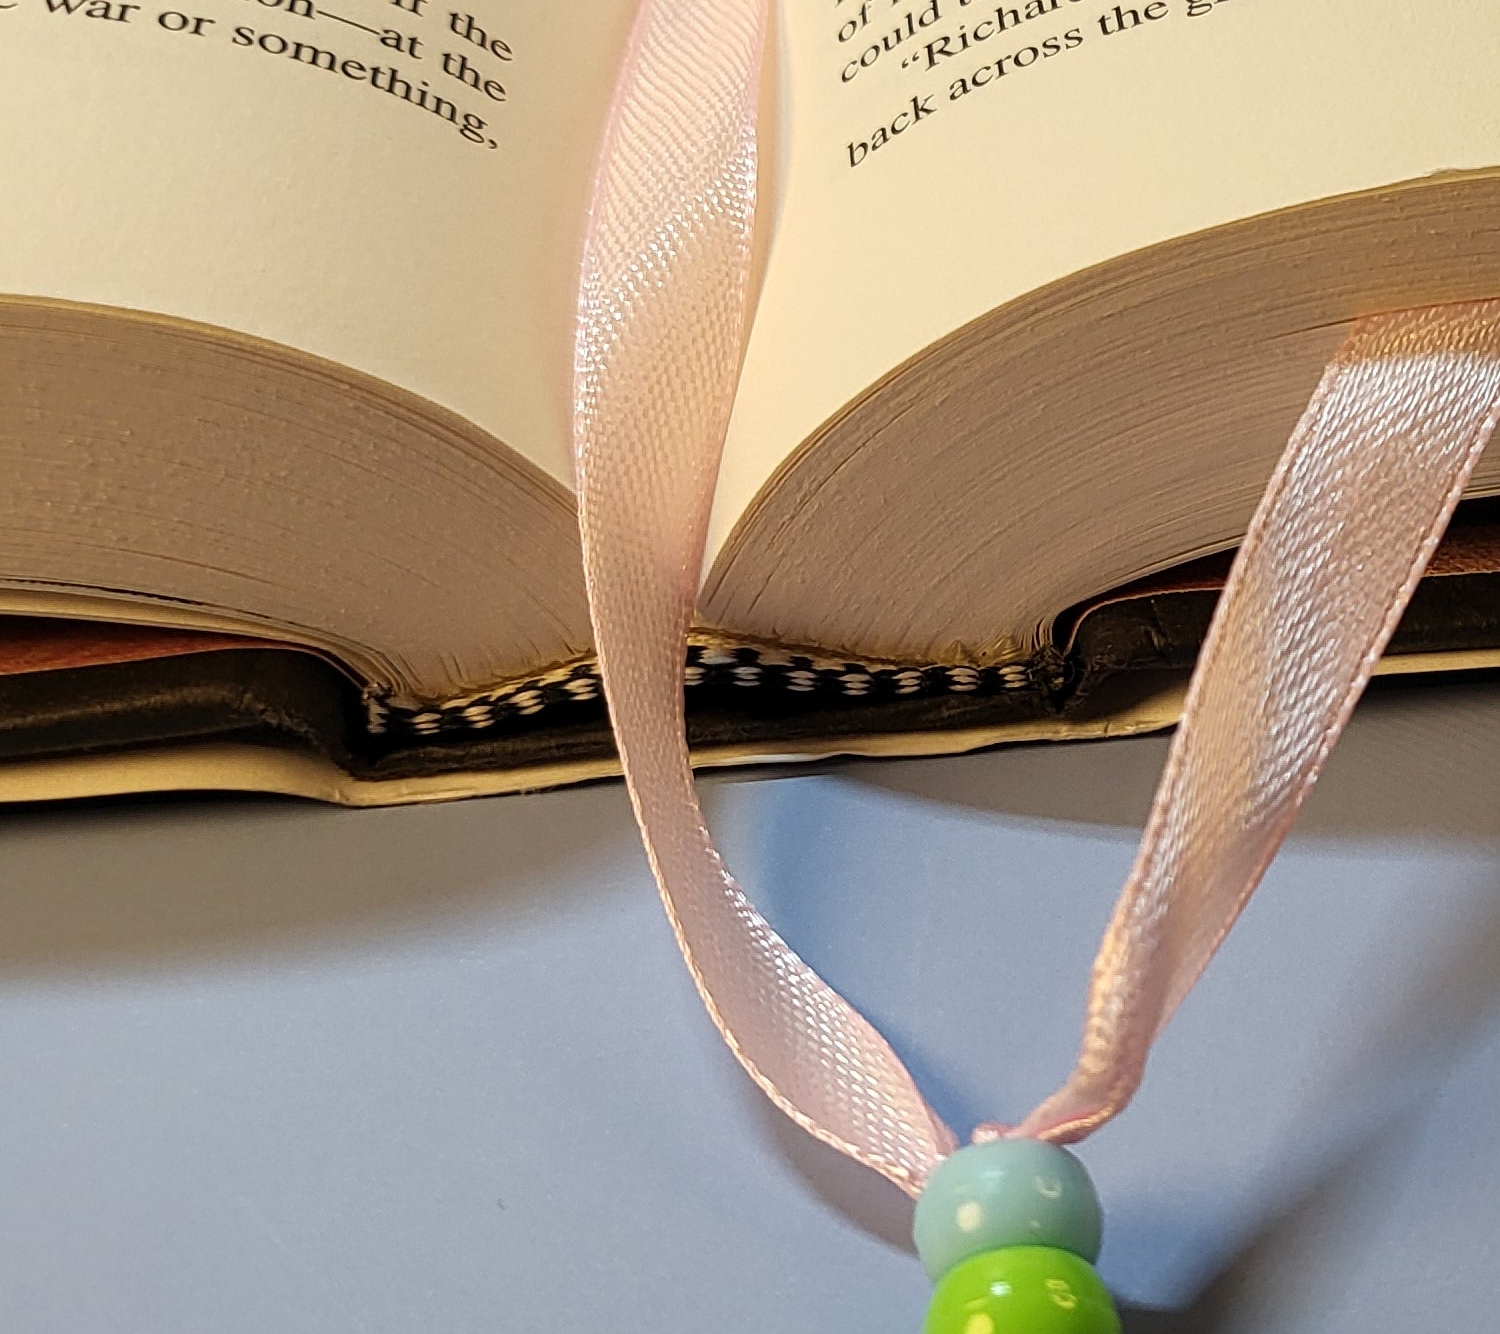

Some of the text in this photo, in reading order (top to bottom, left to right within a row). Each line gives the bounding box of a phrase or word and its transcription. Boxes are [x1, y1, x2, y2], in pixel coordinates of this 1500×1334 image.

[157, 11, 215, 36] or
[231, 26, 498, 150] something,
[442, 52, 506, 102] the
[449, 12, 512, 62] the
[847, 96, 935, 168] back
[949, 28, 1084, 101] across
[1097, 1, 1167, 36] the
